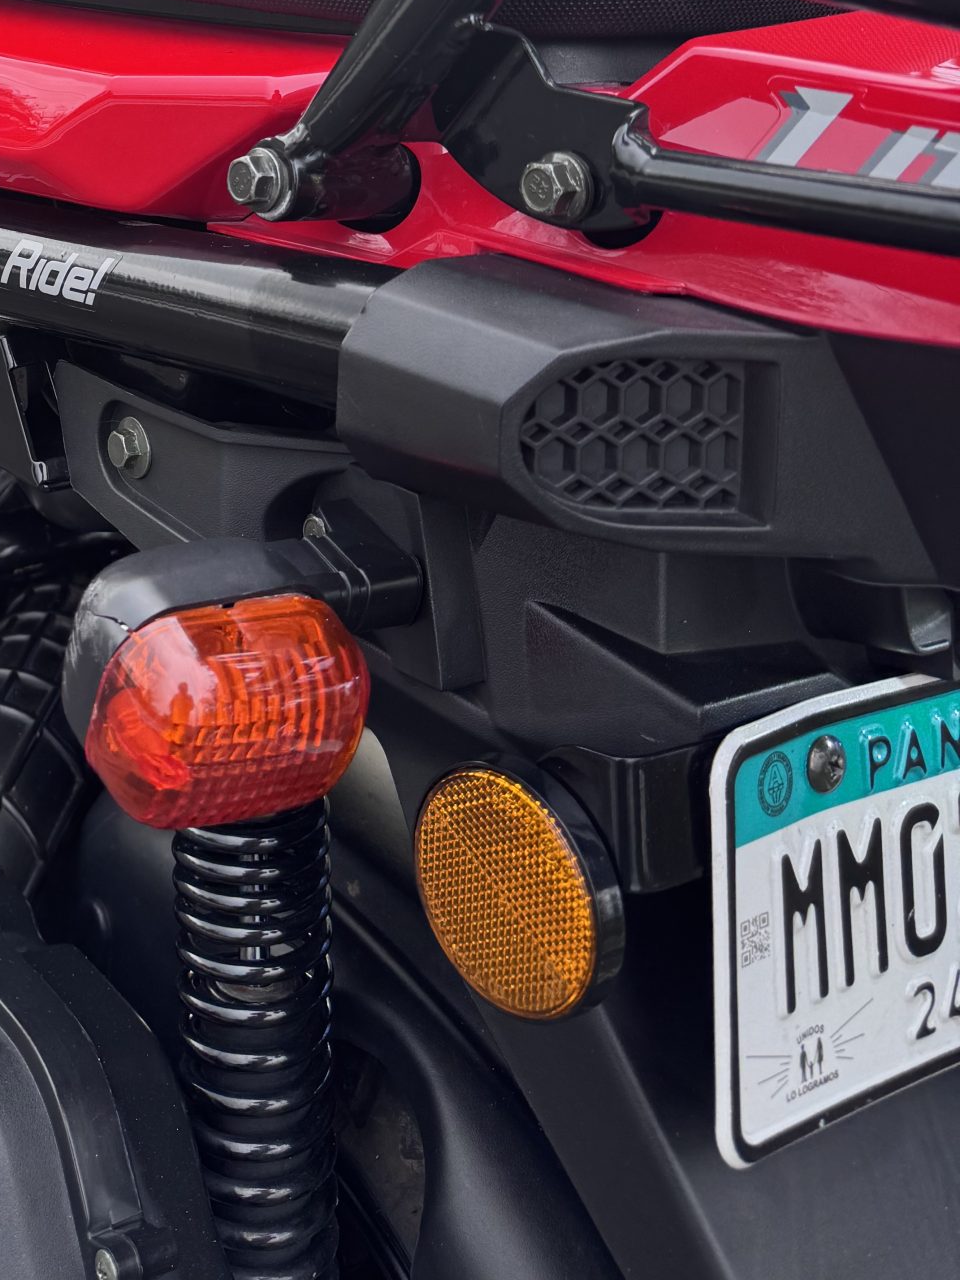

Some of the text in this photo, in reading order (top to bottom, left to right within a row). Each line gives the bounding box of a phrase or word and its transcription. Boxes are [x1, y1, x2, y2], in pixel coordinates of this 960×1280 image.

[0, 239, 116, 306] Ride!
[779, 790, 960, 1016] MM0
[797, 1024, 824, 1044] UNIDOS
[786, 1070, 839, 1102] LO LOGRAMOS
